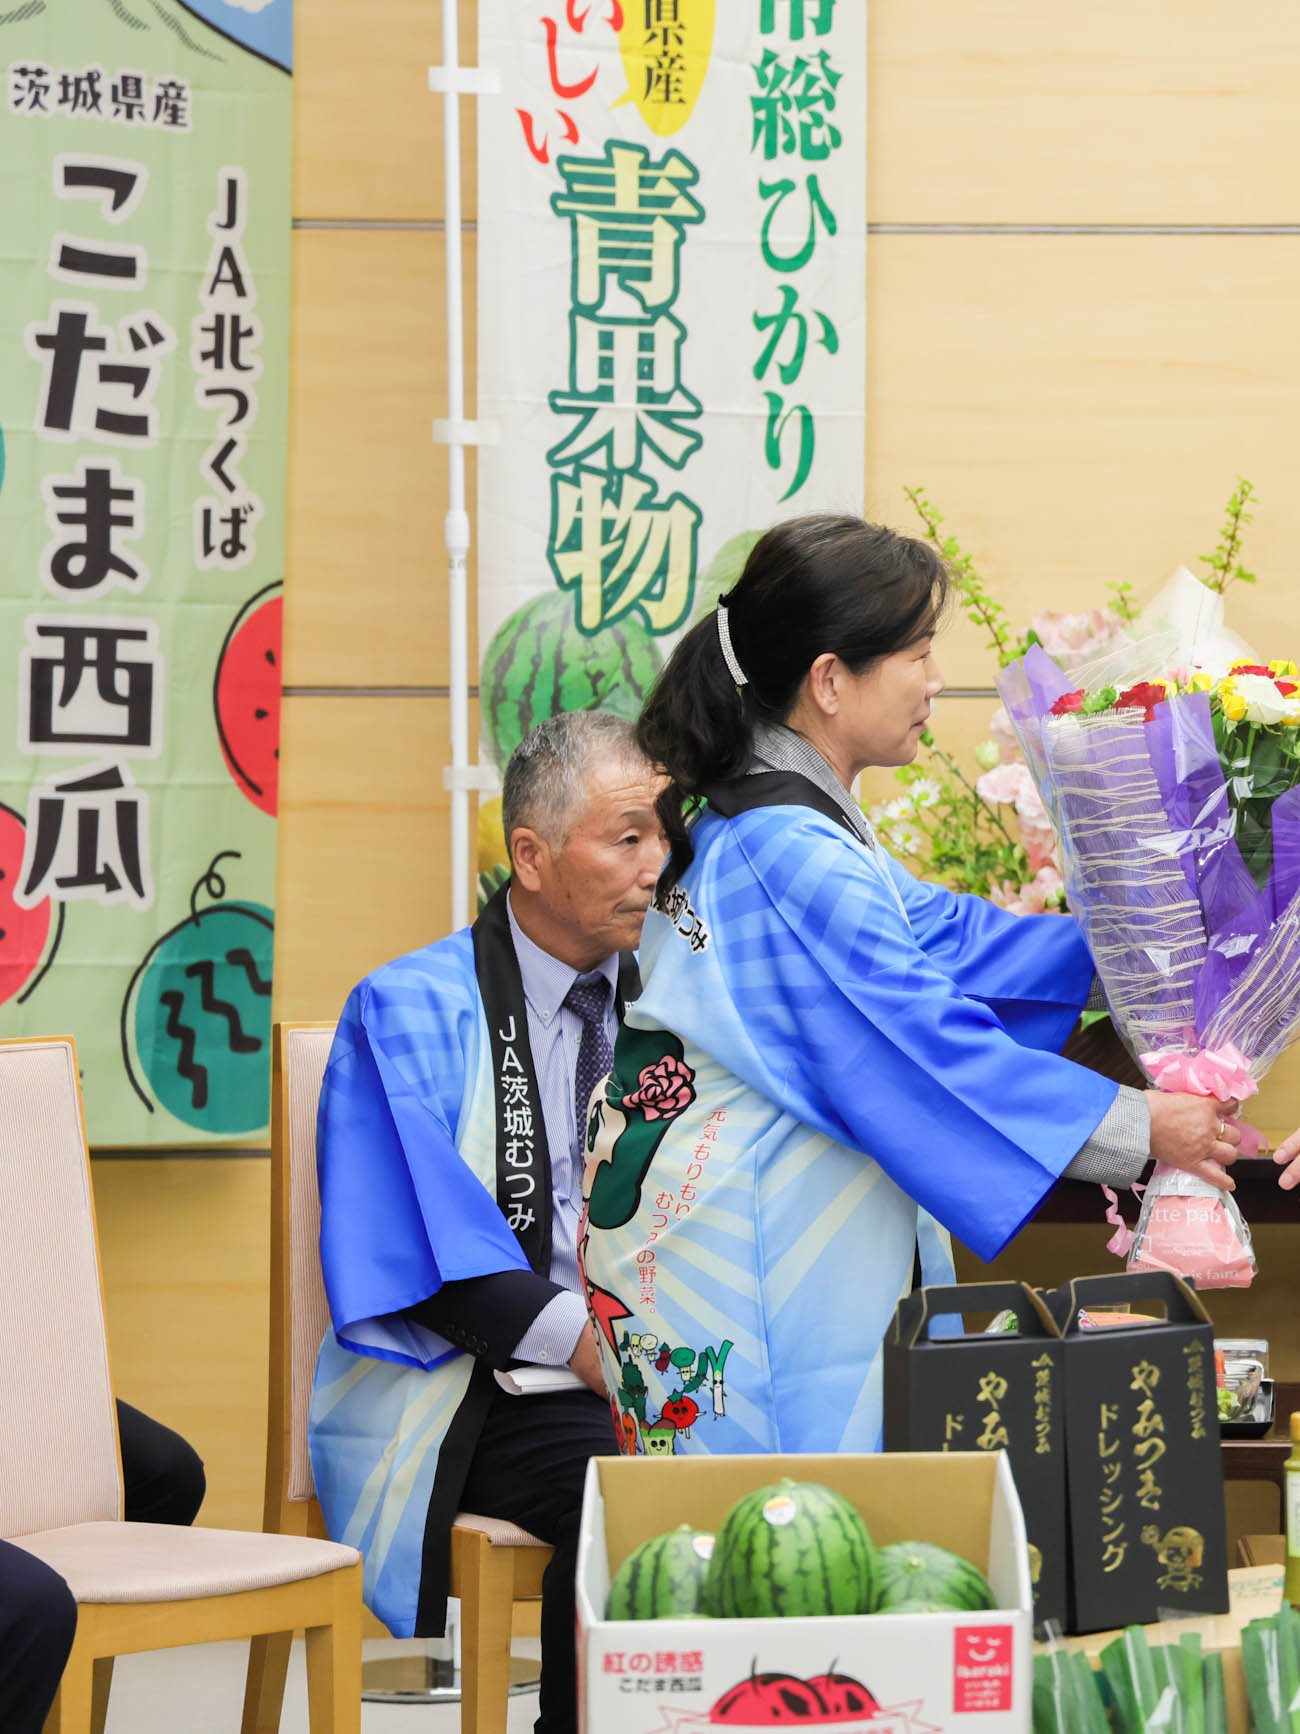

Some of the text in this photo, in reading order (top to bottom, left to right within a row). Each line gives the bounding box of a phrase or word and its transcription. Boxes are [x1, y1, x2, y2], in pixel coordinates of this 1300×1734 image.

[11, 66, 190, 128] 茨城県産
[200, 178, 255, 559] JA北つくば
[546, 139, 706, 638] 青果物
[24, 164, 166, 899] こだま西瓜
[498, 1015, 536, 1233] JA茨城むつみ
[1098, 1402, 1128, 1574] ドレッシング
[1129, 1359, 1167, 1511] やみつき
[603, 1650, 705, 1674] 紅の誘惑
[618, 1676, 705, 1693] こだま西瓜
